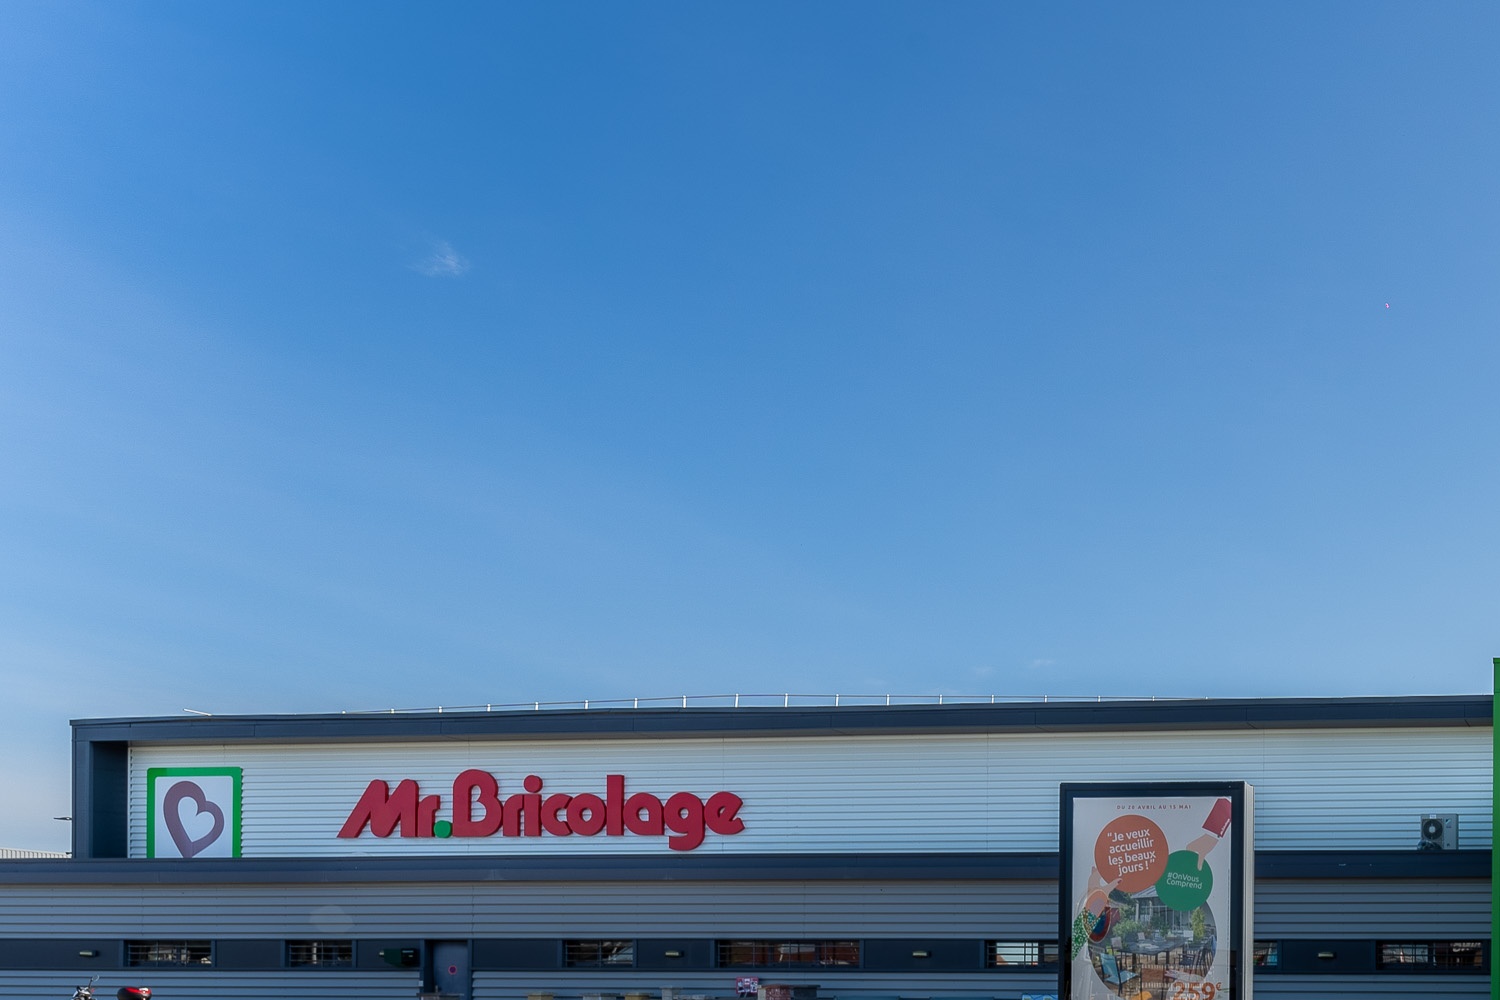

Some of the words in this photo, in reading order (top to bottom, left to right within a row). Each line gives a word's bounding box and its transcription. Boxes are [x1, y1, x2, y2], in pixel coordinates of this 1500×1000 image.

[337, 768, 746, 852] Mr.Bricolage
[1126, 829, 1150, 840] veux
[1109, 837, 1154, 853] accueillir
[1108, 855, 1123, 865] les
[1124, 851, 1156, 863] beaux
[1118, 863, 1144, 877] jours
[1167, 872, 1199, 882] #OnVous
[1166, 878, 1203, 889] Comprend
